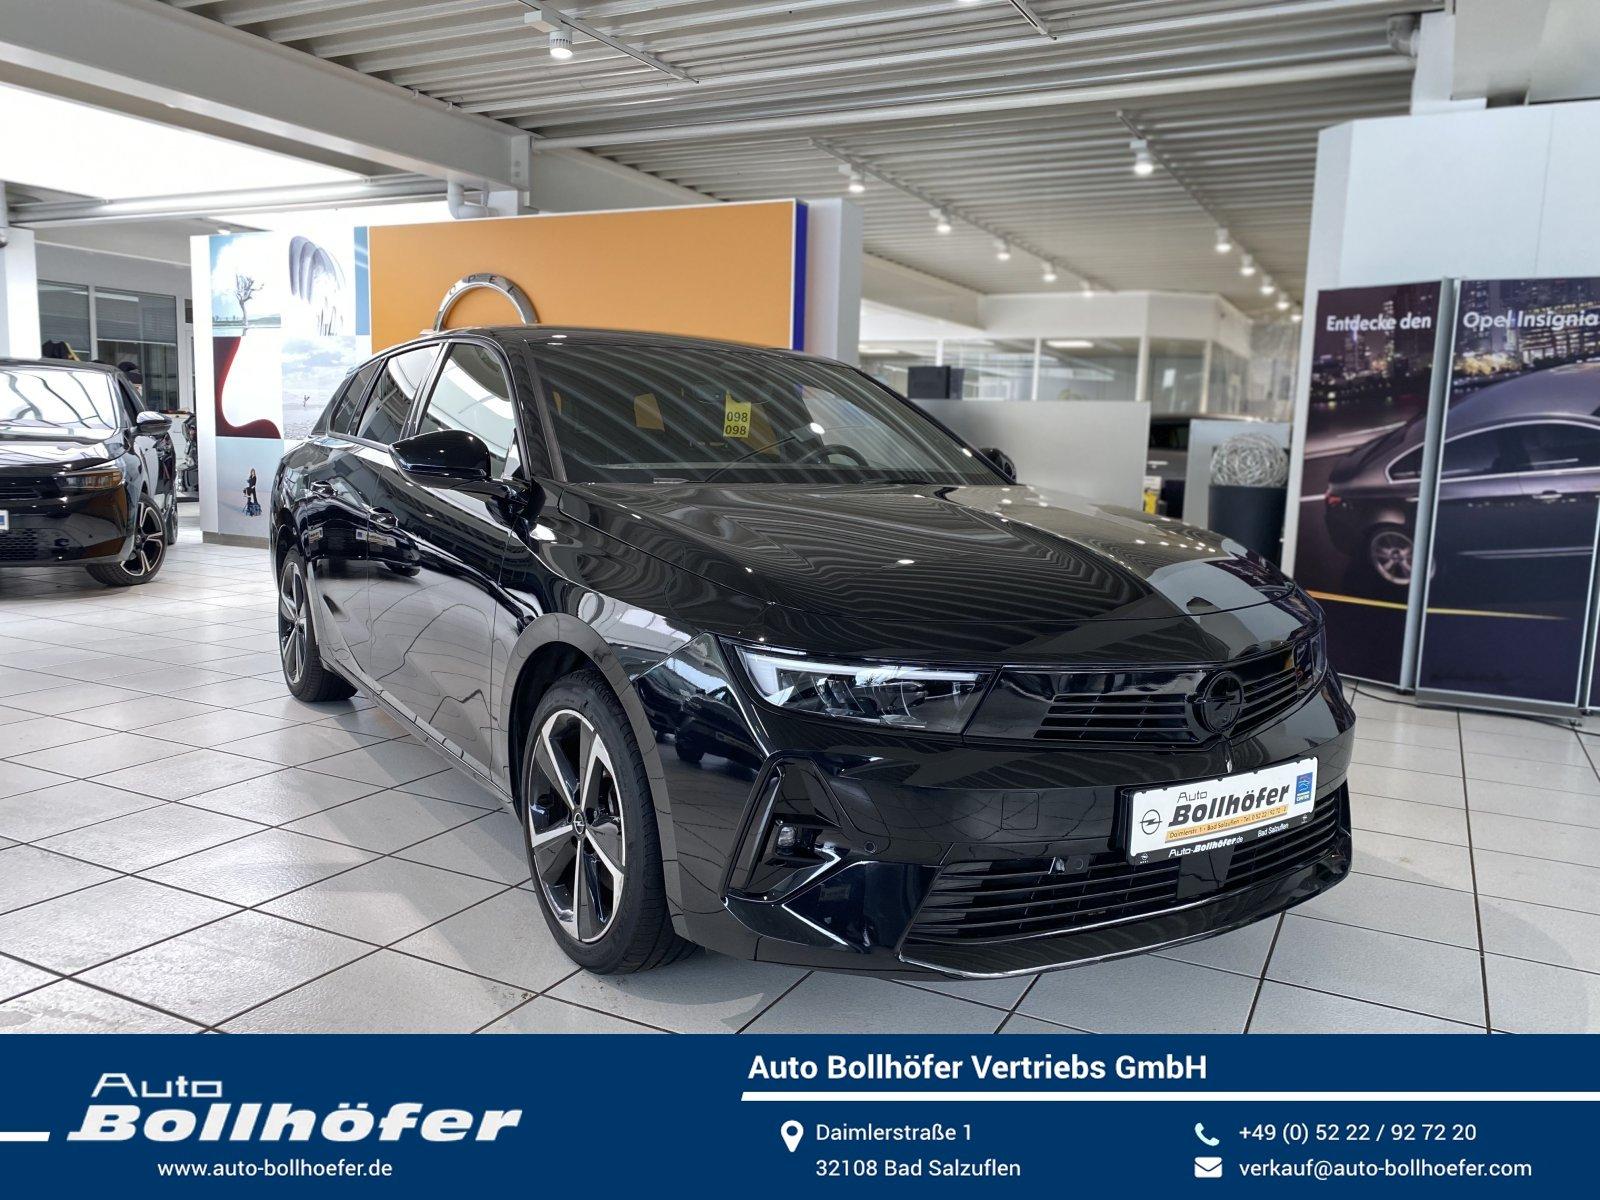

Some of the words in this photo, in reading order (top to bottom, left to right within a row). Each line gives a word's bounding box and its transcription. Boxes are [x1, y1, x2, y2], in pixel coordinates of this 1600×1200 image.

[448, 274, 515, 296] OPEL
[1326, 314, 1397, 332] Entdecke
[1400, 312, 1432, 330] den
[1462, 309, 1513, 332] Opel
[1517, 310, 1600, 332] Insignia
[726, 411, 748, 423] 098
[725, 424, 747, 435] 098
[1168, 784, 1291, 828] Bollhöfer
[1176, 790, 1208, 804] Auto
[1168, 835, 1244, 857] Auto-Bollhöfer.de
